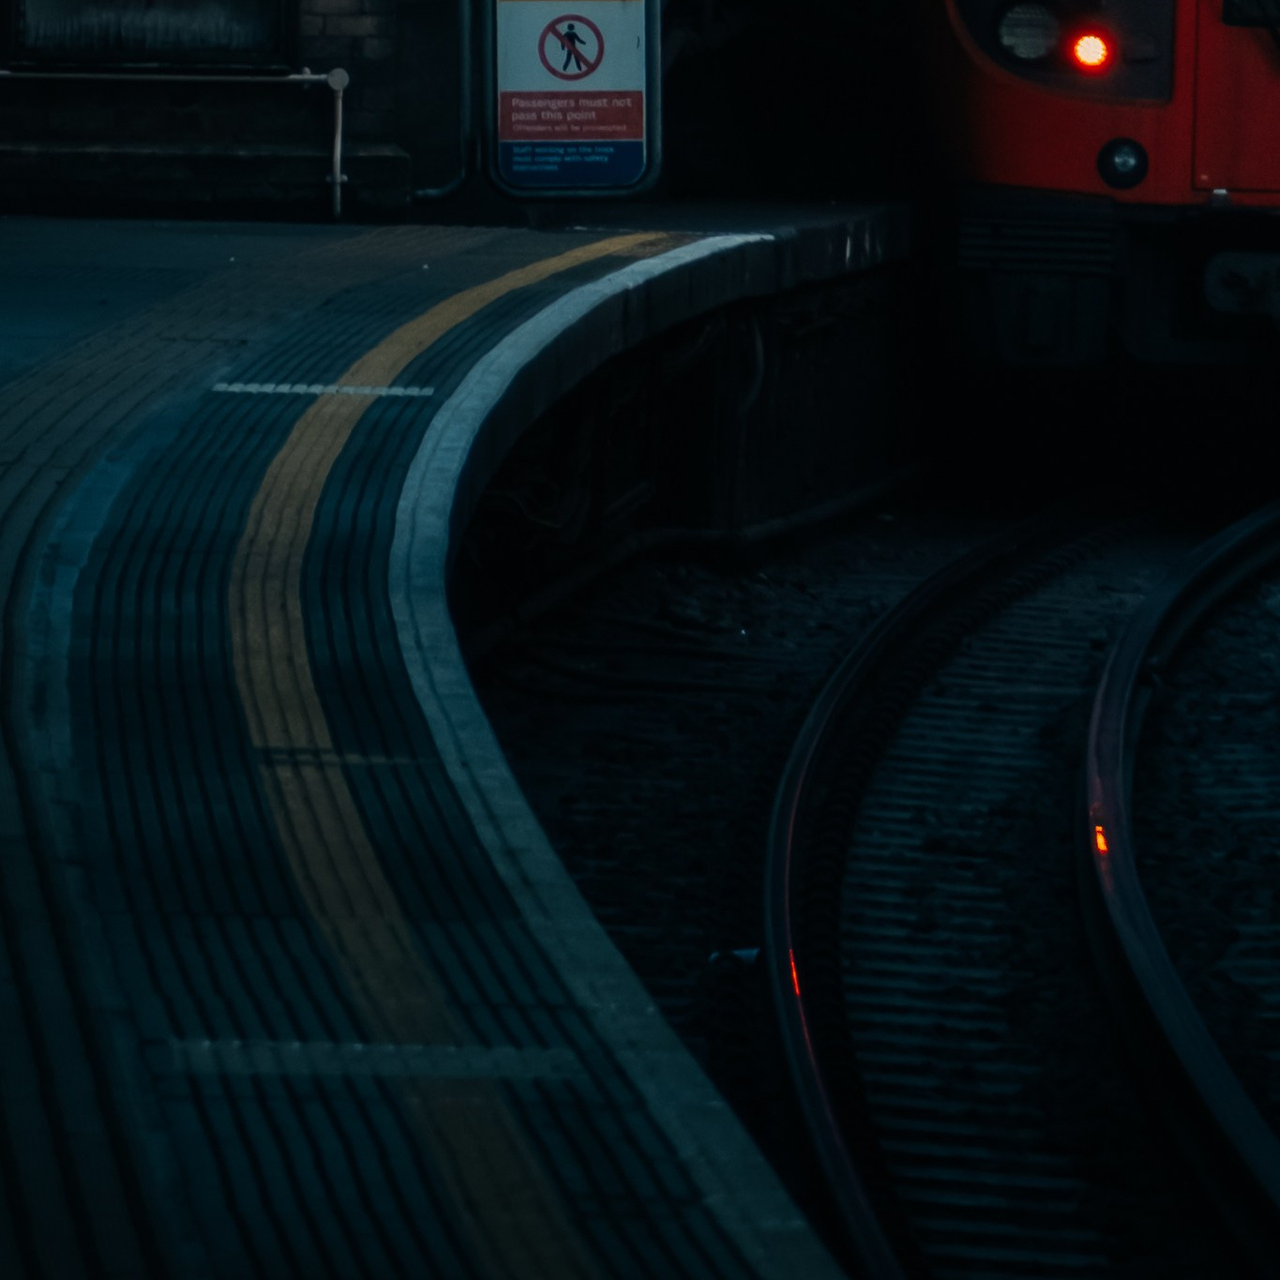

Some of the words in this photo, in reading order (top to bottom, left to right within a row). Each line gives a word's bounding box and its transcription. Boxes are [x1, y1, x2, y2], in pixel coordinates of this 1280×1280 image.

[512, 97, 575, 110] Passengers
[579, 98, 608, 108] must
[612, 98, 632, 107] not
[512, 111, 537, 122] pass
[541, 110, 563, 120] this
[567, 110, 596, 121] point
